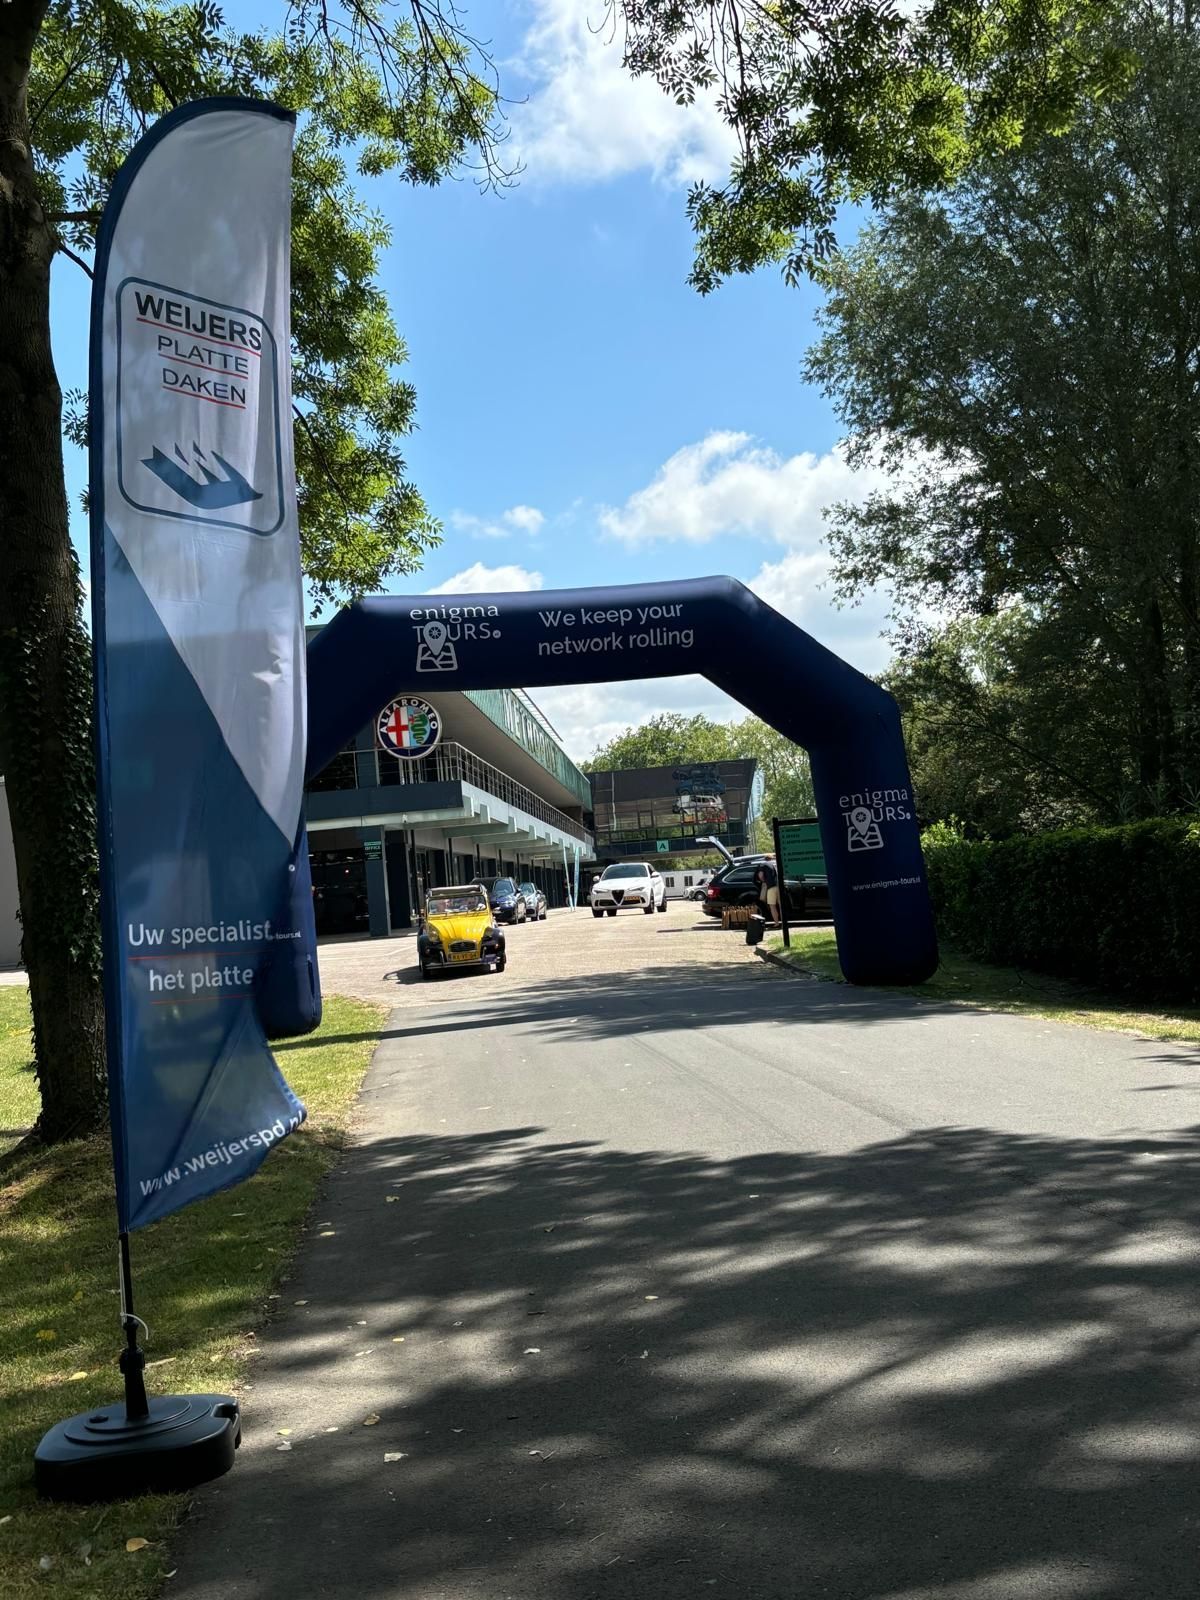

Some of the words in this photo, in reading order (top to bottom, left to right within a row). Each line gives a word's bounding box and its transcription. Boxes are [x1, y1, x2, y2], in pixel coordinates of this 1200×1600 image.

[135, 291, 262, 351] WEIJERS
[158, 335, 248, 375] PLATTE
[162, 368, 246, 405] DAKEN
[409, 604, 500, 624] enigma
[538, 610, 575, 628] We
[581, 607, 632, 628] keep
[637, 603, 683, 625] your
[538, 632, 622, 655] network
[628, 627, 694, 649] rolling
[839, 788, 909, 808] enigma
[852, 876, 921, 891] www.enigma-tours.nl
[128, 923, 165, 946] Uw
[170, 919, 273, 948] specialist
[149, 968, 184, 992] het
[191, 964, 253, 994] platte
